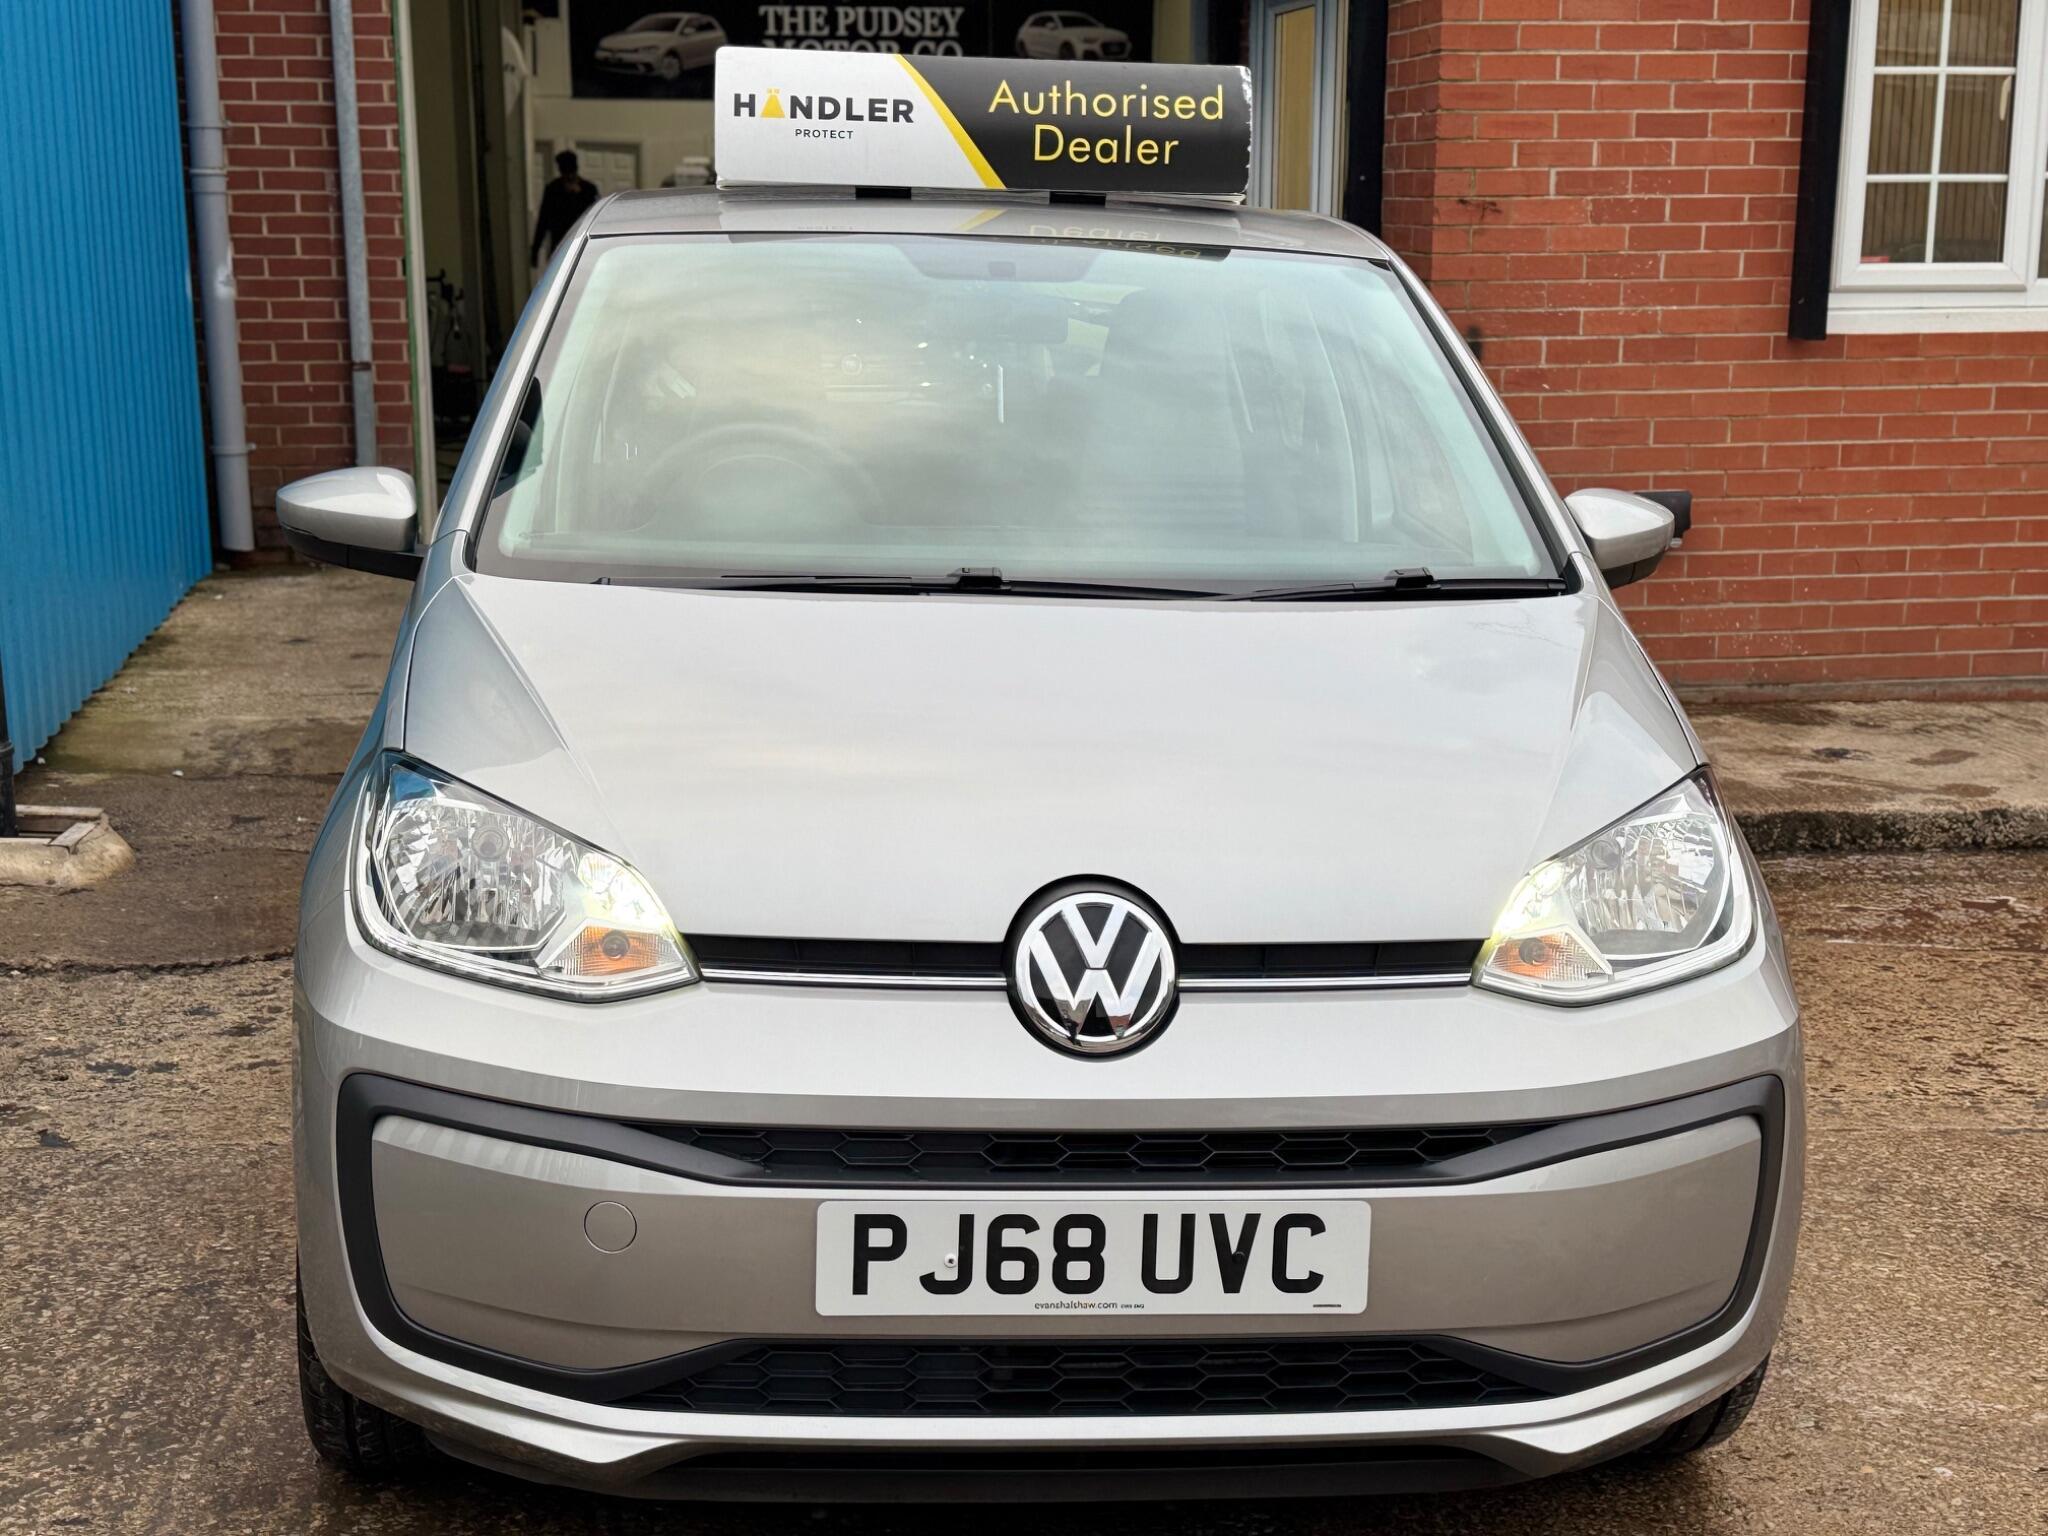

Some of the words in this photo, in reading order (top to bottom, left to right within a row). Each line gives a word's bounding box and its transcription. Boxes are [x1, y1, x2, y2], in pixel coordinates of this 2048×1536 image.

[758, 5, 830, 37] THE
[834, 6, 965, 38] PUDSEY
[988, 79, 1224, 120] Authorised
[795, 128, 854, 140] PROTECT
[1033, 125, 1179, 165] Dealer
[852, 1213, 1107, 1295] PJ68
[1141, 1213, 1327, 1294] UVC
[1034, 1300, 1118, 1310] evanshalshaw.com
